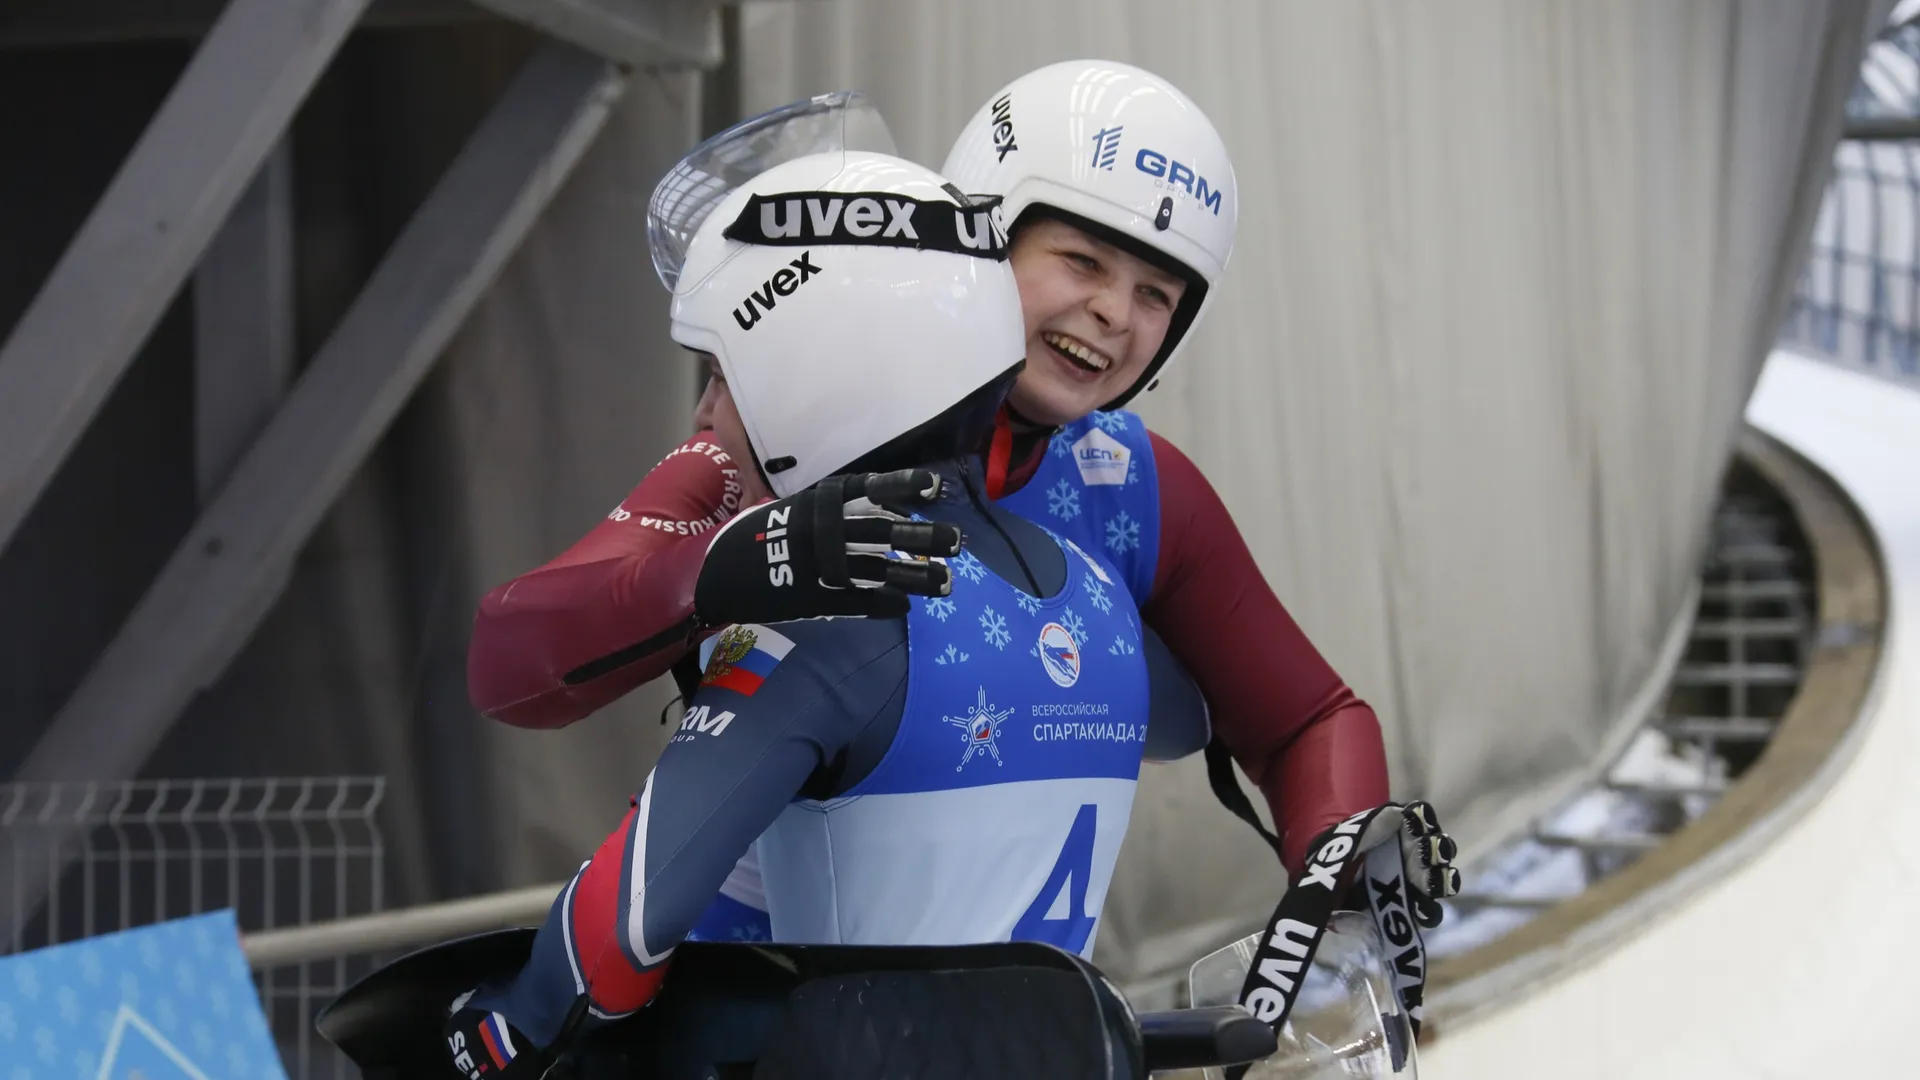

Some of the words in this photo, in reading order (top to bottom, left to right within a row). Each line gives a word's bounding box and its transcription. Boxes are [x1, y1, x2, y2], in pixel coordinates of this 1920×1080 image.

[992, 92, 1018, 164] uvex
[1135, 148, 1222, 216] GRM
[760, 198, 919, 240] uvex
[733, 251, 822, 331] uvex
[680, 705, 736, 737] RM
[1032, 702, 1109, 717] ВСЕРОССИЙСКАЯ
[1033, 722, 1136, 743] СПАРТАКИАДА
[1011, 804, 1098, 957] 4
[1298, 807, 1377, 891] vex
[1246, 918, 1318, 1024] uve
[447, 1030, 485, 1080] SEI
